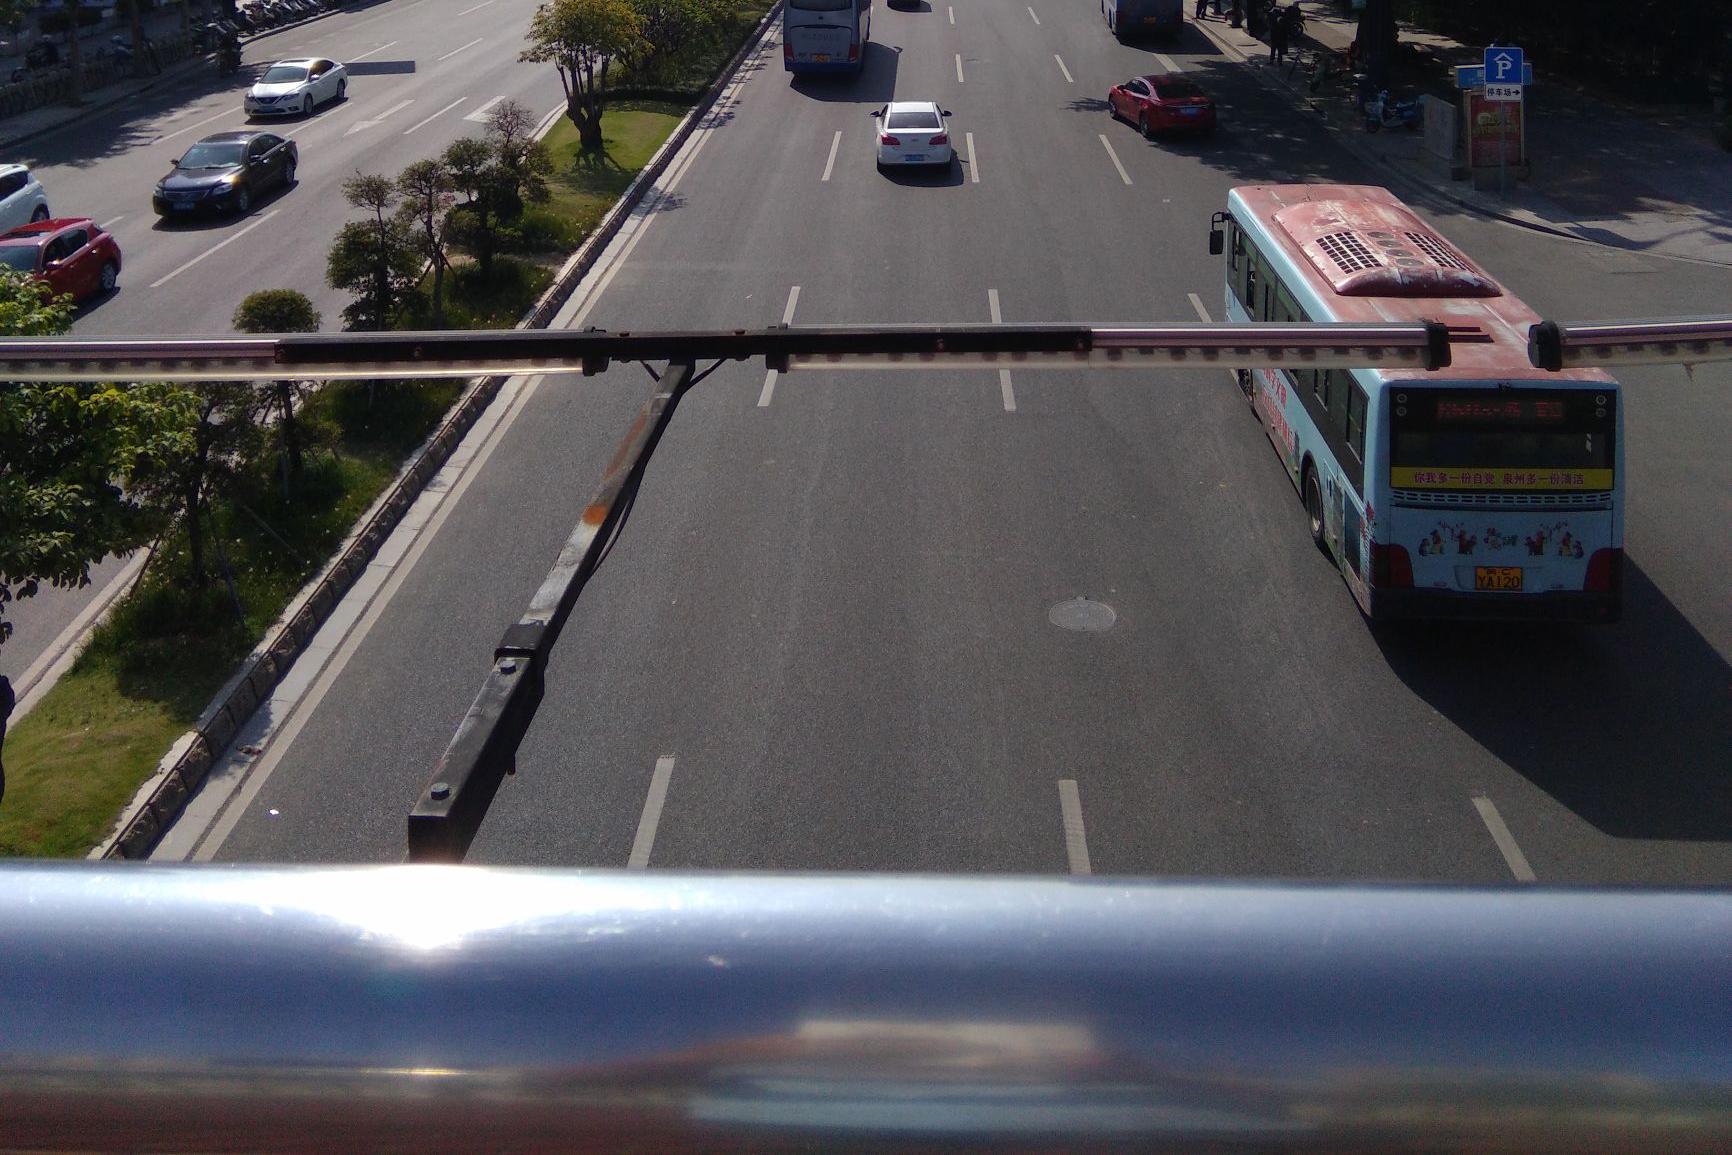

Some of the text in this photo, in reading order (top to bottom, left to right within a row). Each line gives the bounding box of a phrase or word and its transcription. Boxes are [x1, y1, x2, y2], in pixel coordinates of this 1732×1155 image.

[1496, 60, 1511, 78] P
[1487, 89, 1511, 97] 停车场
[1413, 471, 1585, 486] 你我多一份自觉 泉州多一份清洁
[1478, 575, 1521, 588] YA120
